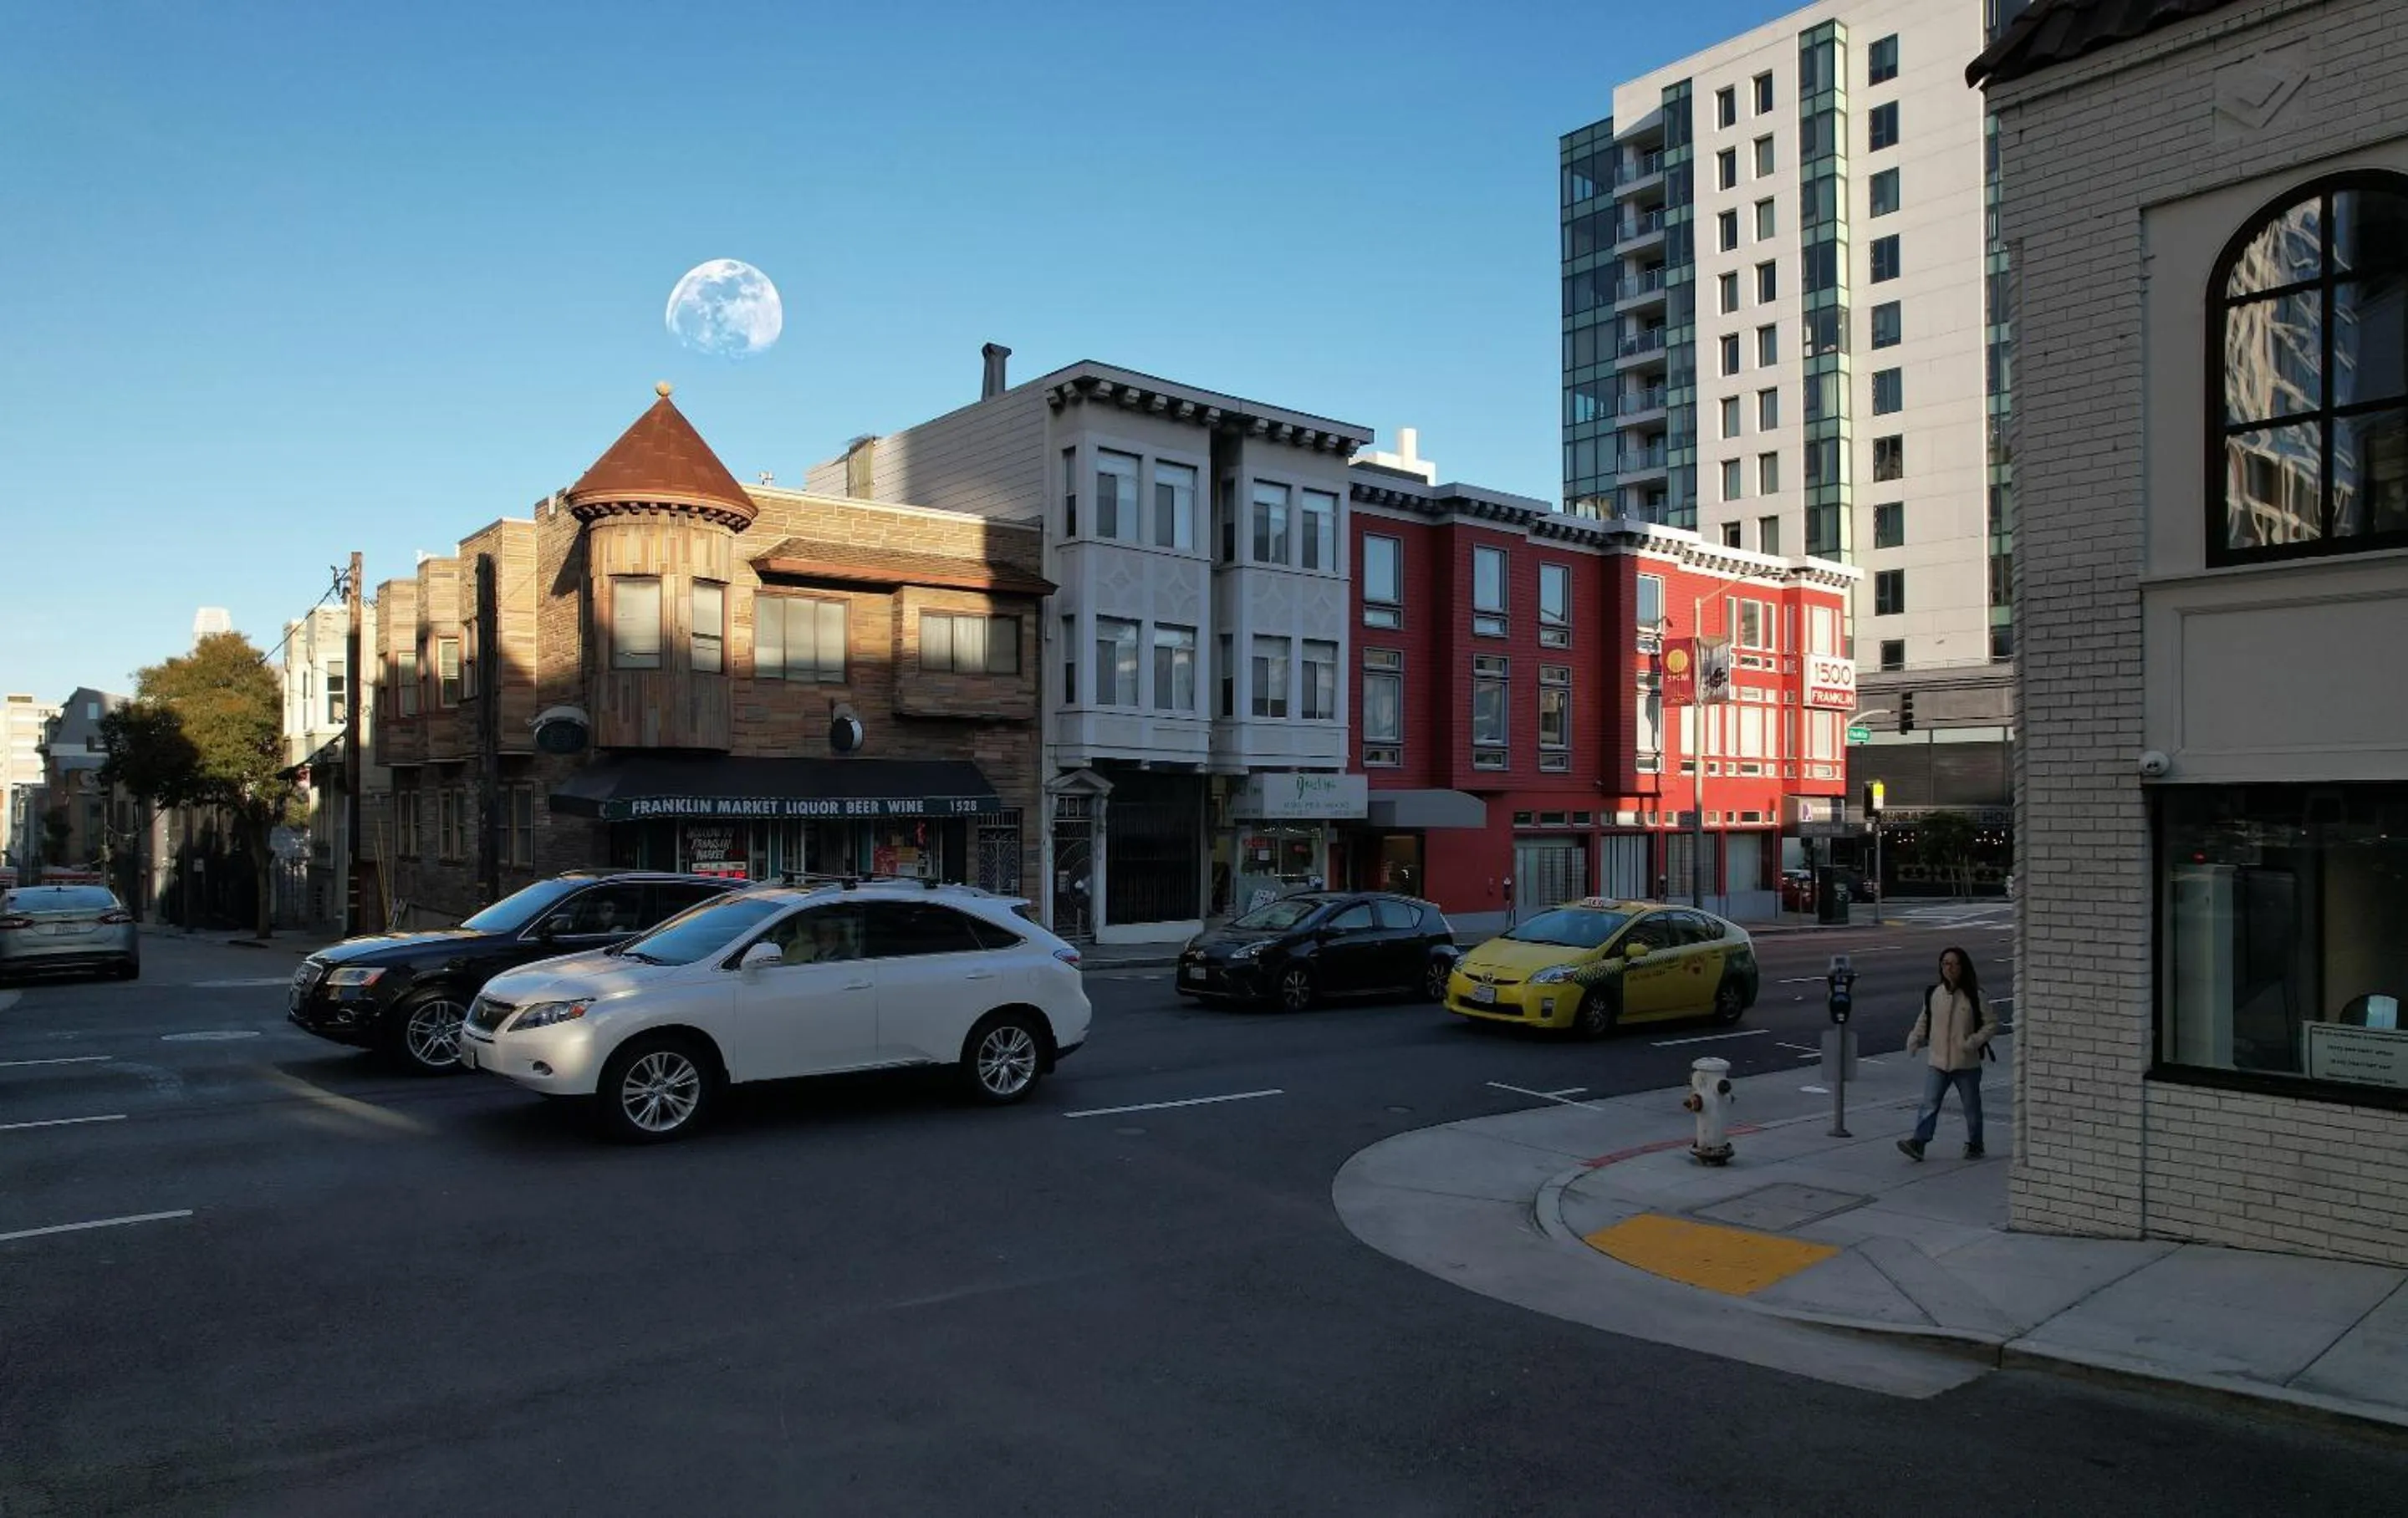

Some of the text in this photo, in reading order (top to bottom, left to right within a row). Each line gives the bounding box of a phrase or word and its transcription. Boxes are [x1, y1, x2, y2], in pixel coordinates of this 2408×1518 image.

[1814, 662, 1851, 685] 1500
[1812, 690, 1854, 706] FRANKLIN
[631, 798, 977, 816] FRANKLIN MARKET LIQUOR BEER WINE 1528
